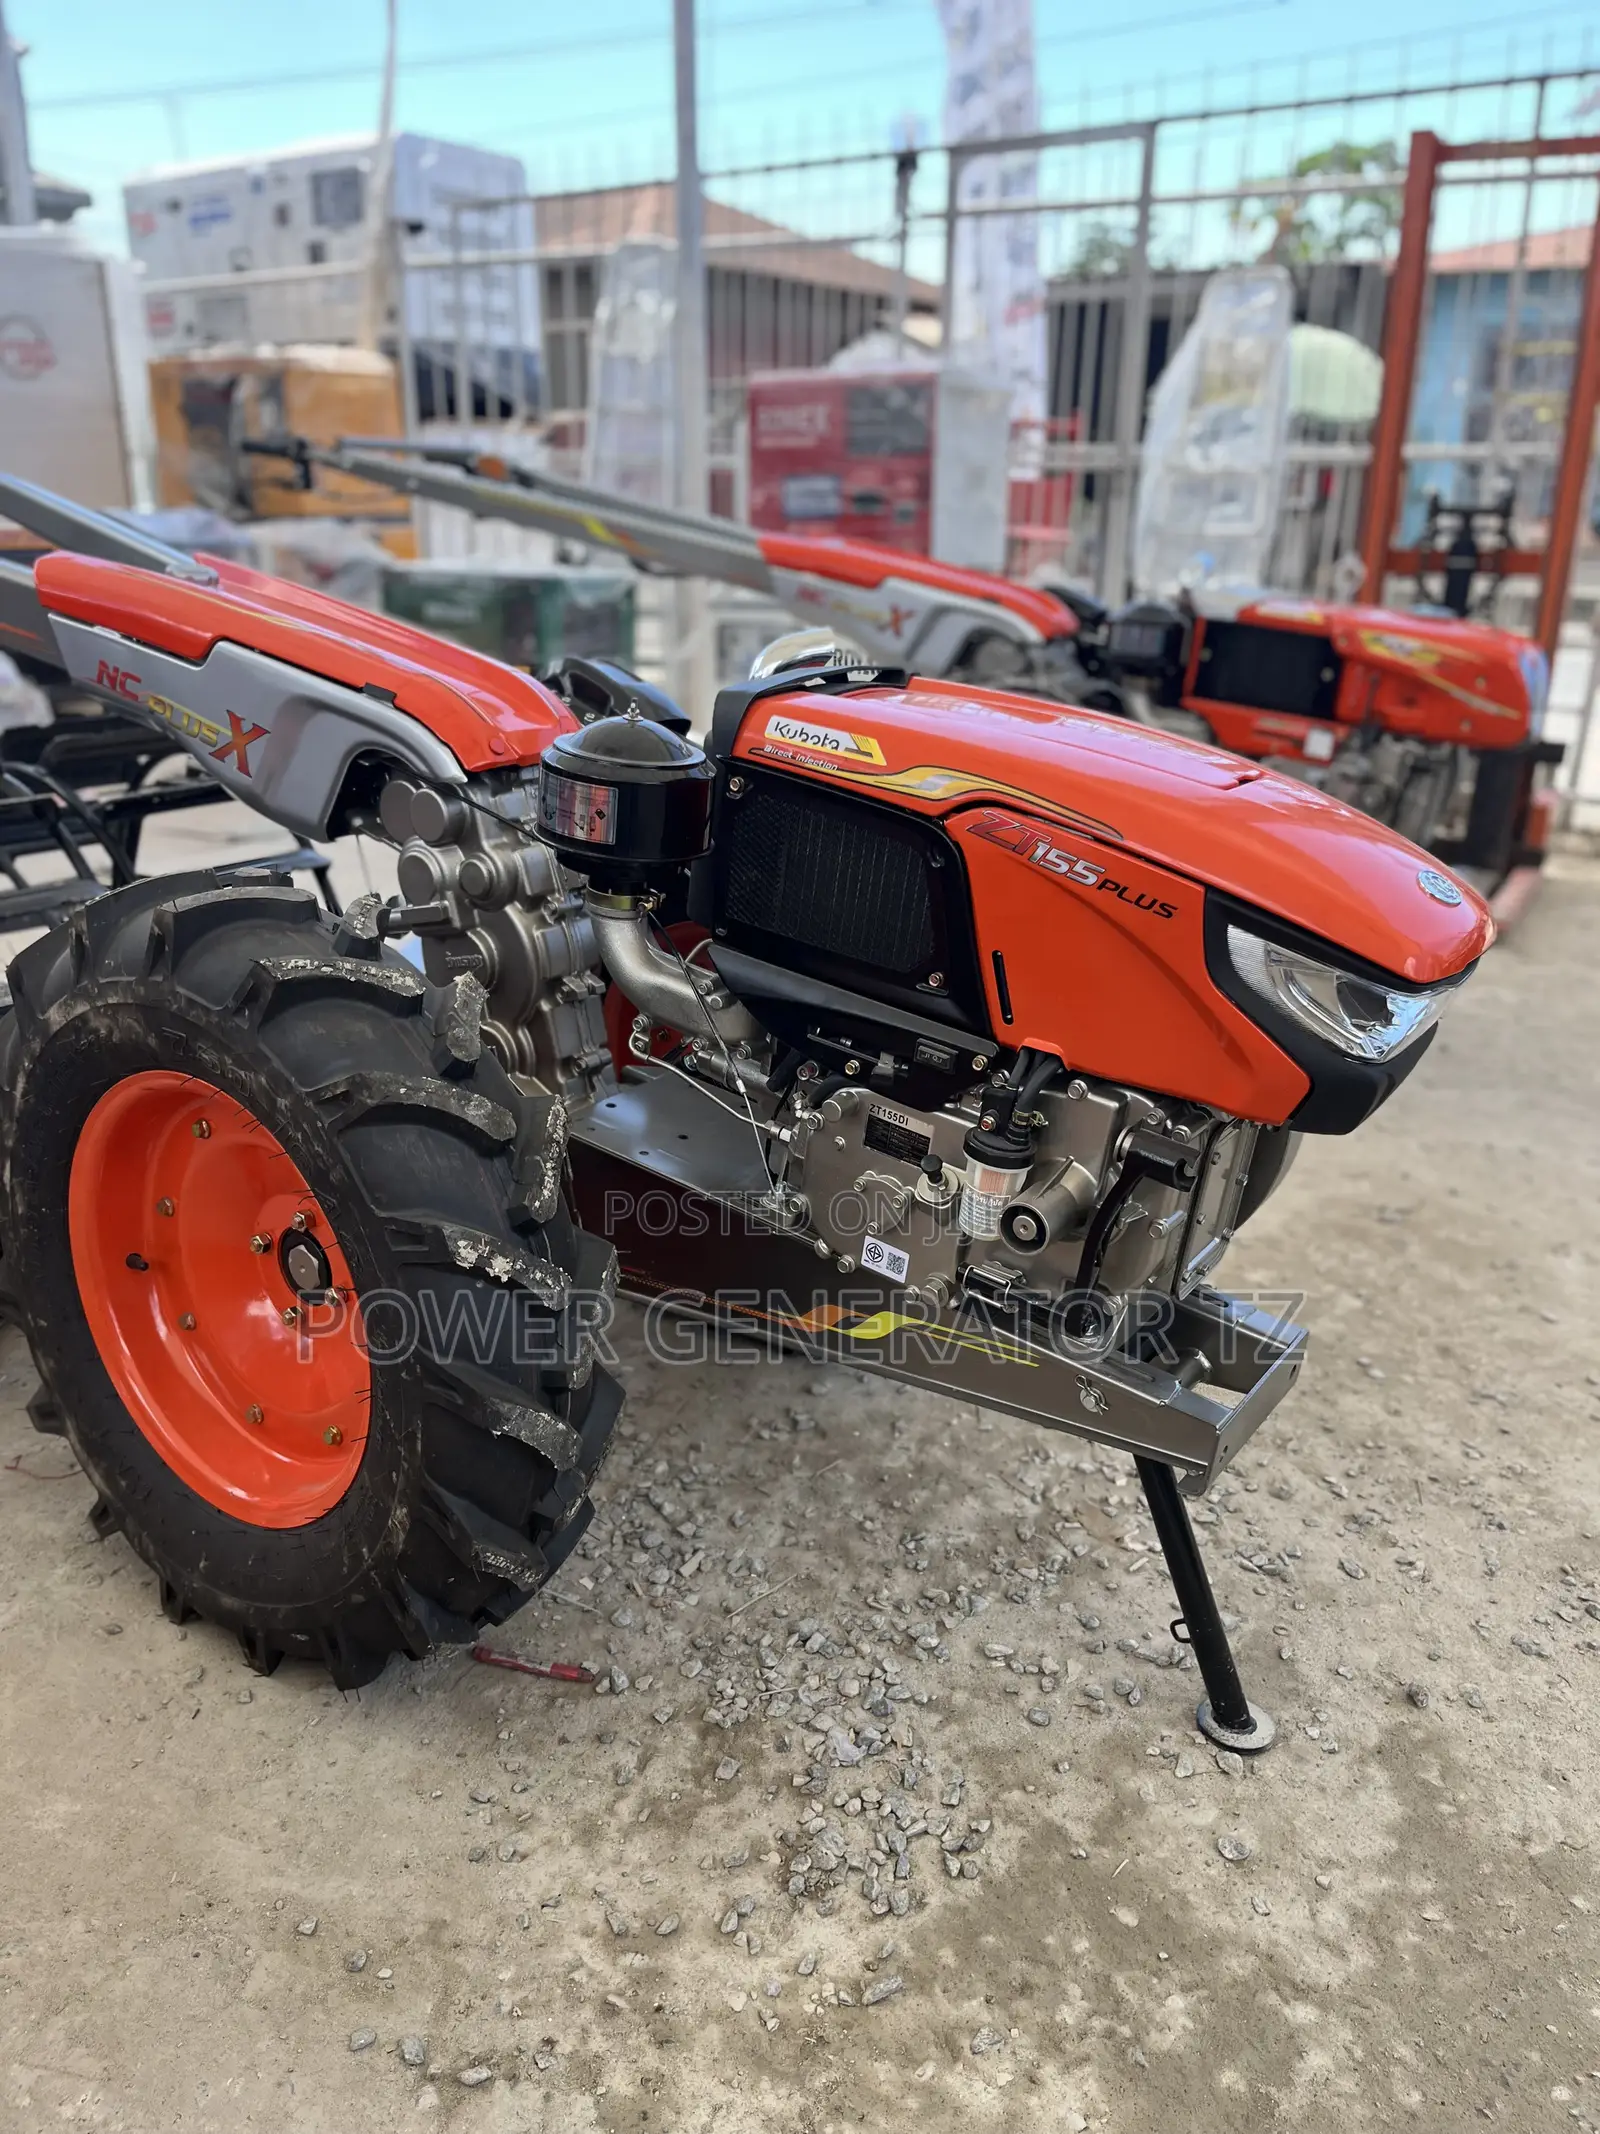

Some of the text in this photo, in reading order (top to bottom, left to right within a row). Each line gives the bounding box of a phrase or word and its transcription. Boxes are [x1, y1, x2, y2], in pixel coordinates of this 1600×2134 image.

[96, 660, 142, 701] NC
[149, 694, 220, 747] PLUS
[774, 721, 840, 751] Kubota
[763, 744, 839, 772] Direct Injection
[1096, 878, 1179, 919] PLUS
[869, 1103, 909, 1126] ZT155DI
